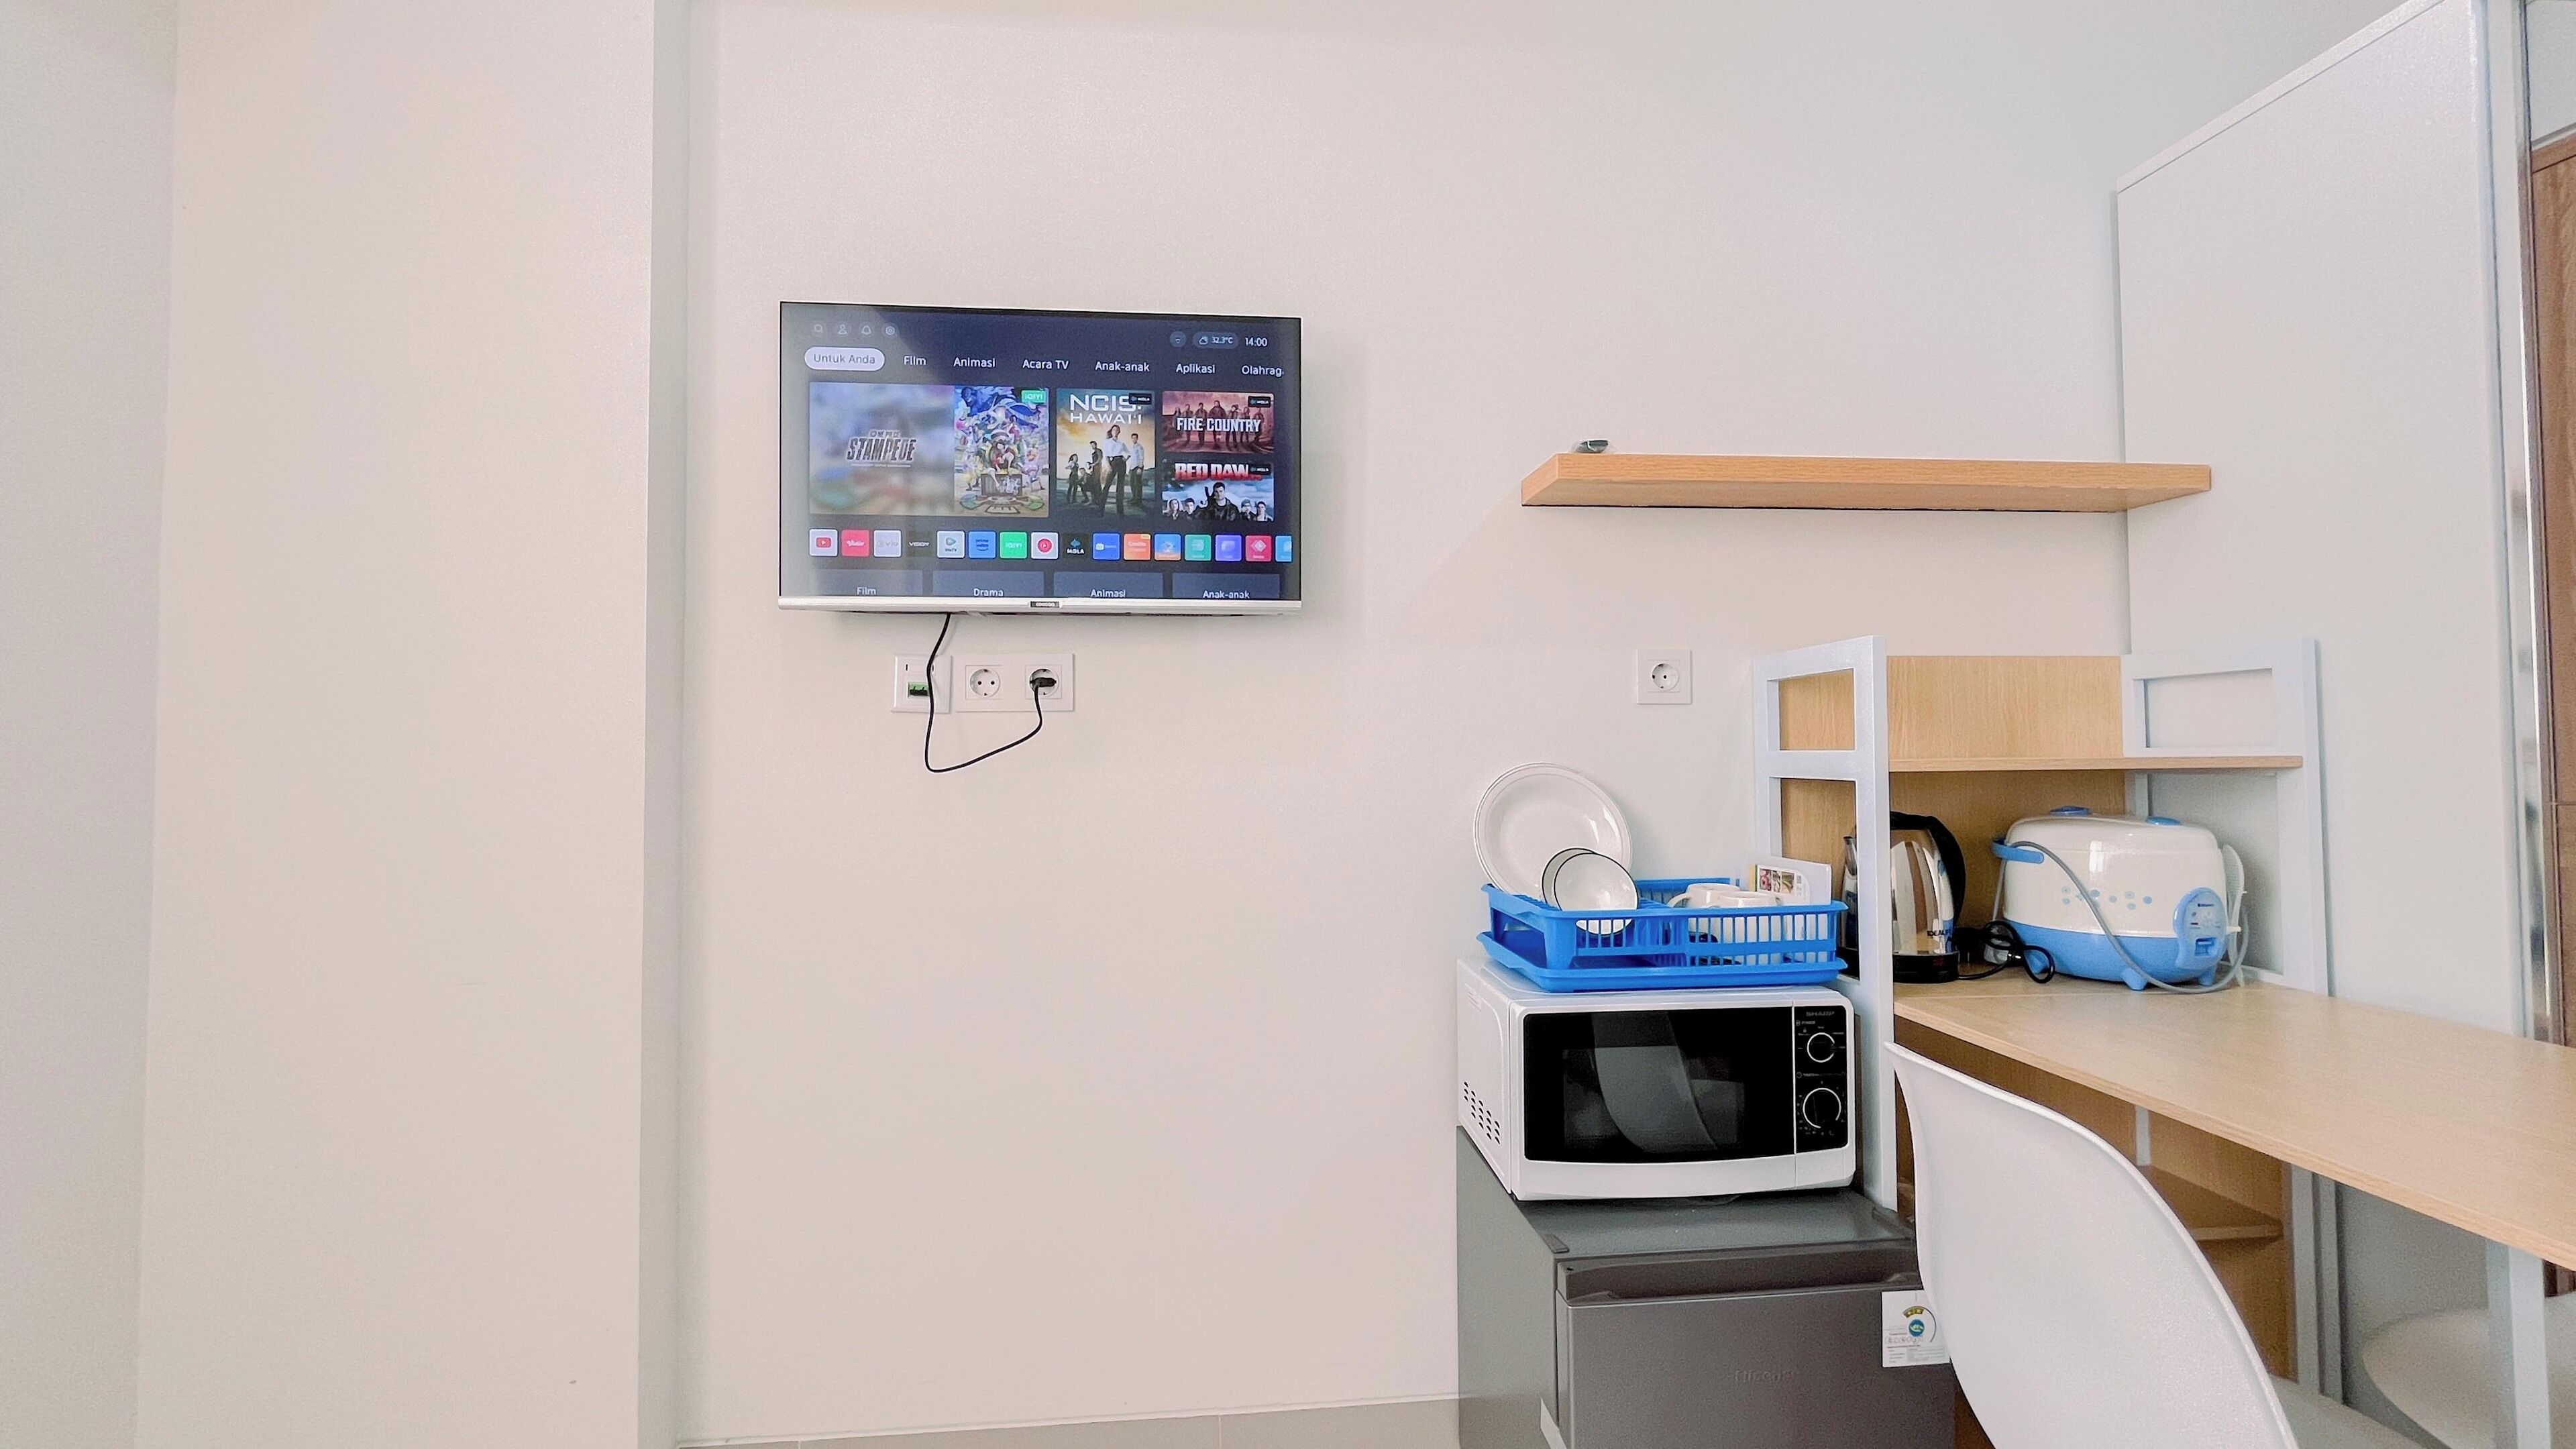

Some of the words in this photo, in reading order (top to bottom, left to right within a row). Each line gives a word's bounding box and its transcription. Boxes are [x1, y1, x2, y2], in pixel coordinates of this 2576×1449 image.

[1245, 337, 1267, 346] 14:00
[813, 353, 845, 364] Untuk
[849, 354, 875, 364] Anda
[904, 355, 926, 366] Film
[953, 357, 996, 368] Animasi
[1022, 360, 1053, 370] Acara
[1055, 360, 1069, 370] TV
[1095, 361, 1150, 372] Anak-anak
[1175, 364, 1216, 374] Aplikasi
[1242, 365, 1284, 377] Olahrag
[1176, 417, 1203, 431] FIRE
[1206, 418, 1262, 433] COUNTRY
[846, 437, 917, 461] STAMPEDE
[1175, 463, 1208, 481] RED
[1210, 463, 1263, 481] DAW
[856, 586, 877, 596] Film
[973, 588, 1004, 596] Drama
[1090, 589, 1126, 598] Animasi
[1202, 590, 1250, 599] Anak-anak
